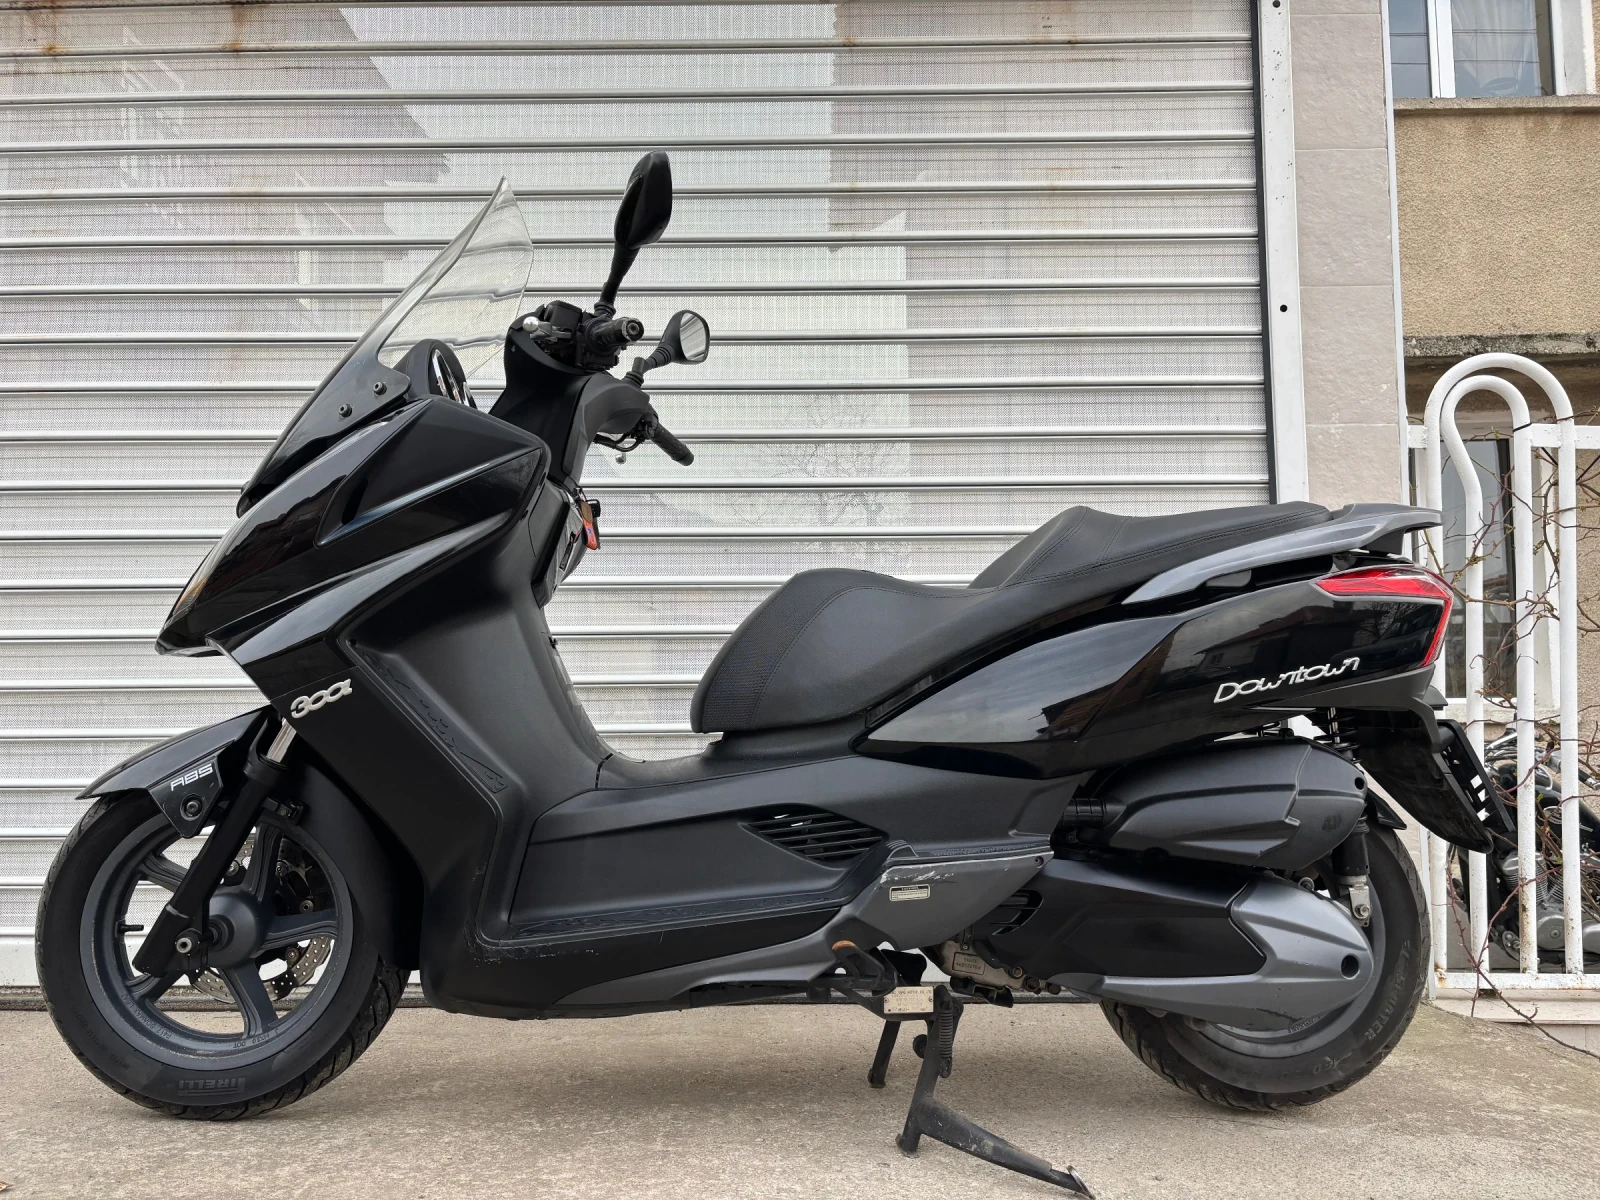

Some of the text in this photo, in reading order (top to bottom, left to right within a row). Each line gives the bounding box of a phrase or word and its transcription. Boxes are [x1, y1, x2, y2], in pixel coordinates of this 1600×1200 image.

[1213, 656, 1361, 704] Downtown
[170, 763, 213, 792] ABS
[178, 1077, 246, 1097] PIRELLI
